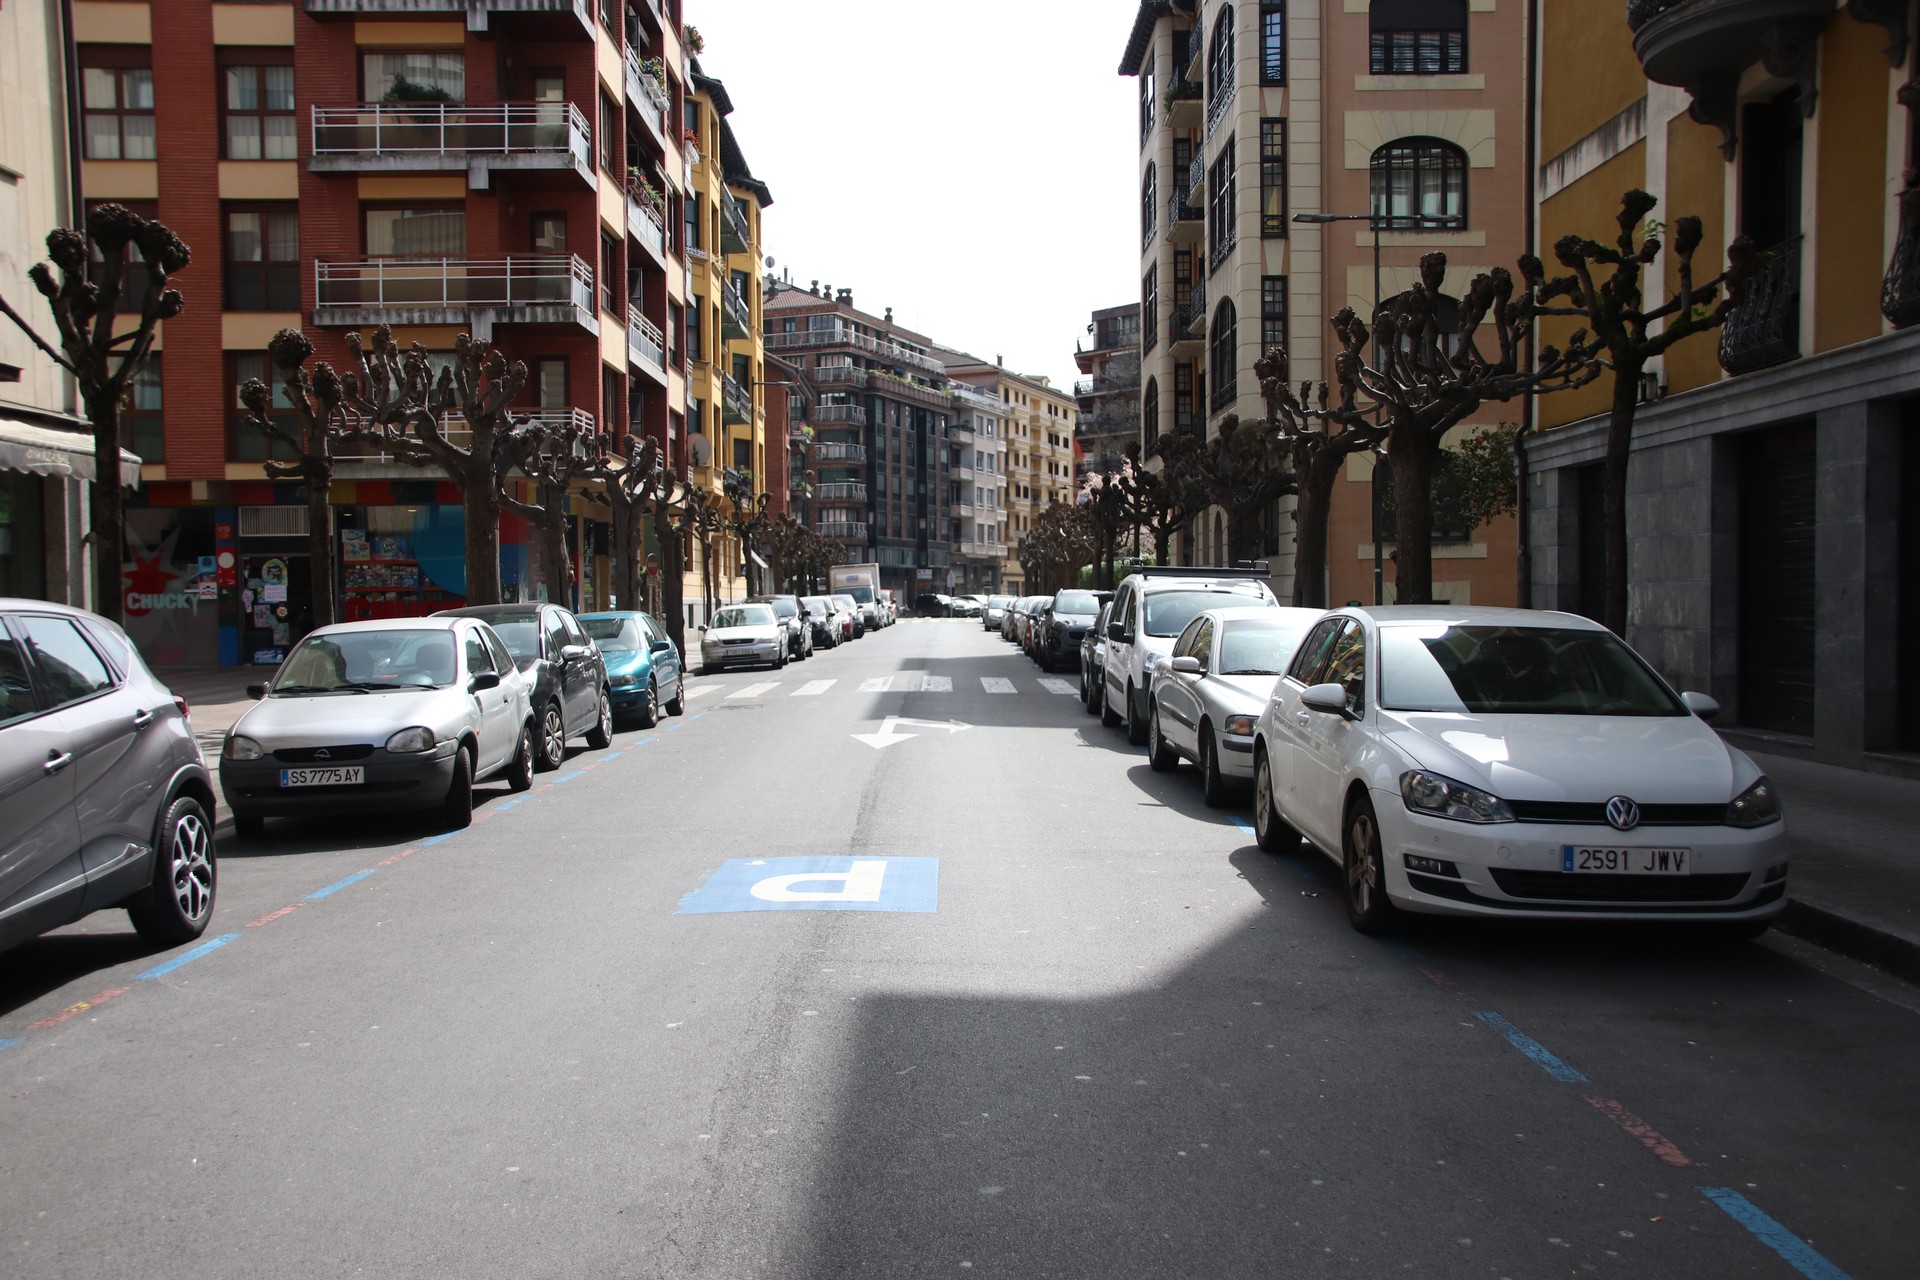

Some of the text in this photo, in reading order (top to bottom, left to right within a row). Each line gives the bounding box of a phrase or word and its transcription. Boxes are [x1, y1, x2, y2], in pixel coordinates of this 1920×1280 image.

[127, 592, 199, 617] CHUCKY
[1578, 849, 1629, 871] 2591
[1643, 850, 1685, 872] JWV
